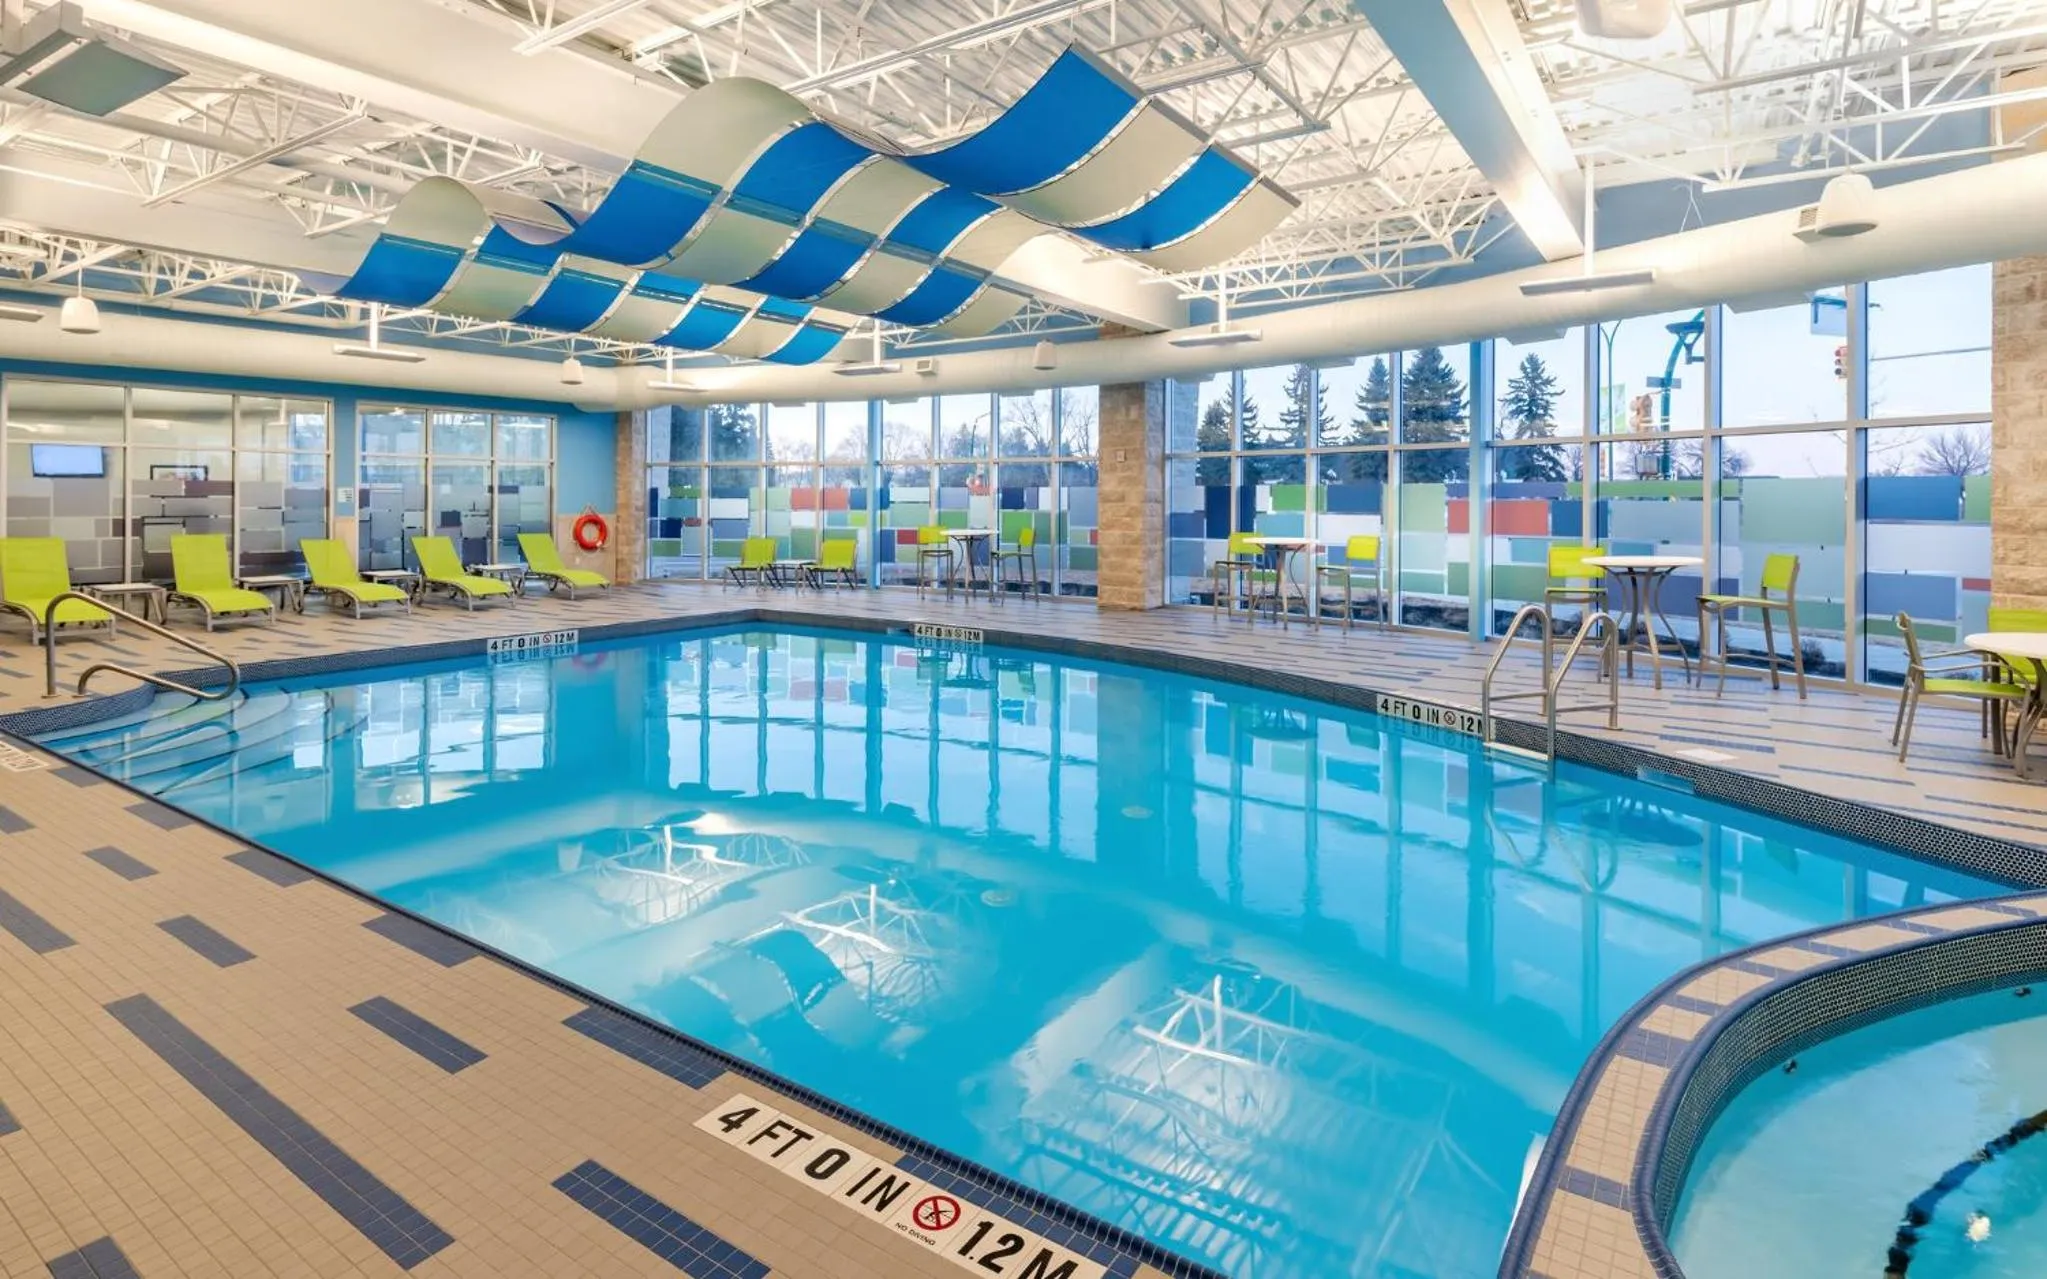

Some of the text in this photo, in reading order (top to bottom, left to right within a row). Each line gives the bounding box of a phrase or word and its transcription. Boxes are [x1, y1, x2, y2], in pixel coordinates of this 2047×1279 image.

[917, 625, 922, 634] 4
[925, 626, 933, 636] FT
[490, 640, 498, 650] 4
[502, 639, 513, 650] FT
[529, 636, 540, 646] IN
[1381, 698, 1389, 712] 4
[1394, 701, 1407, 717] FT
[1427, 707, 1439, 724] IN
[718, 1107, 760, 1133] 4
[746, 1119, 815, 1158] FT
[845, 1167, 911, 1213] IN
[895, 1222, 936, 1246] NO DIVING
